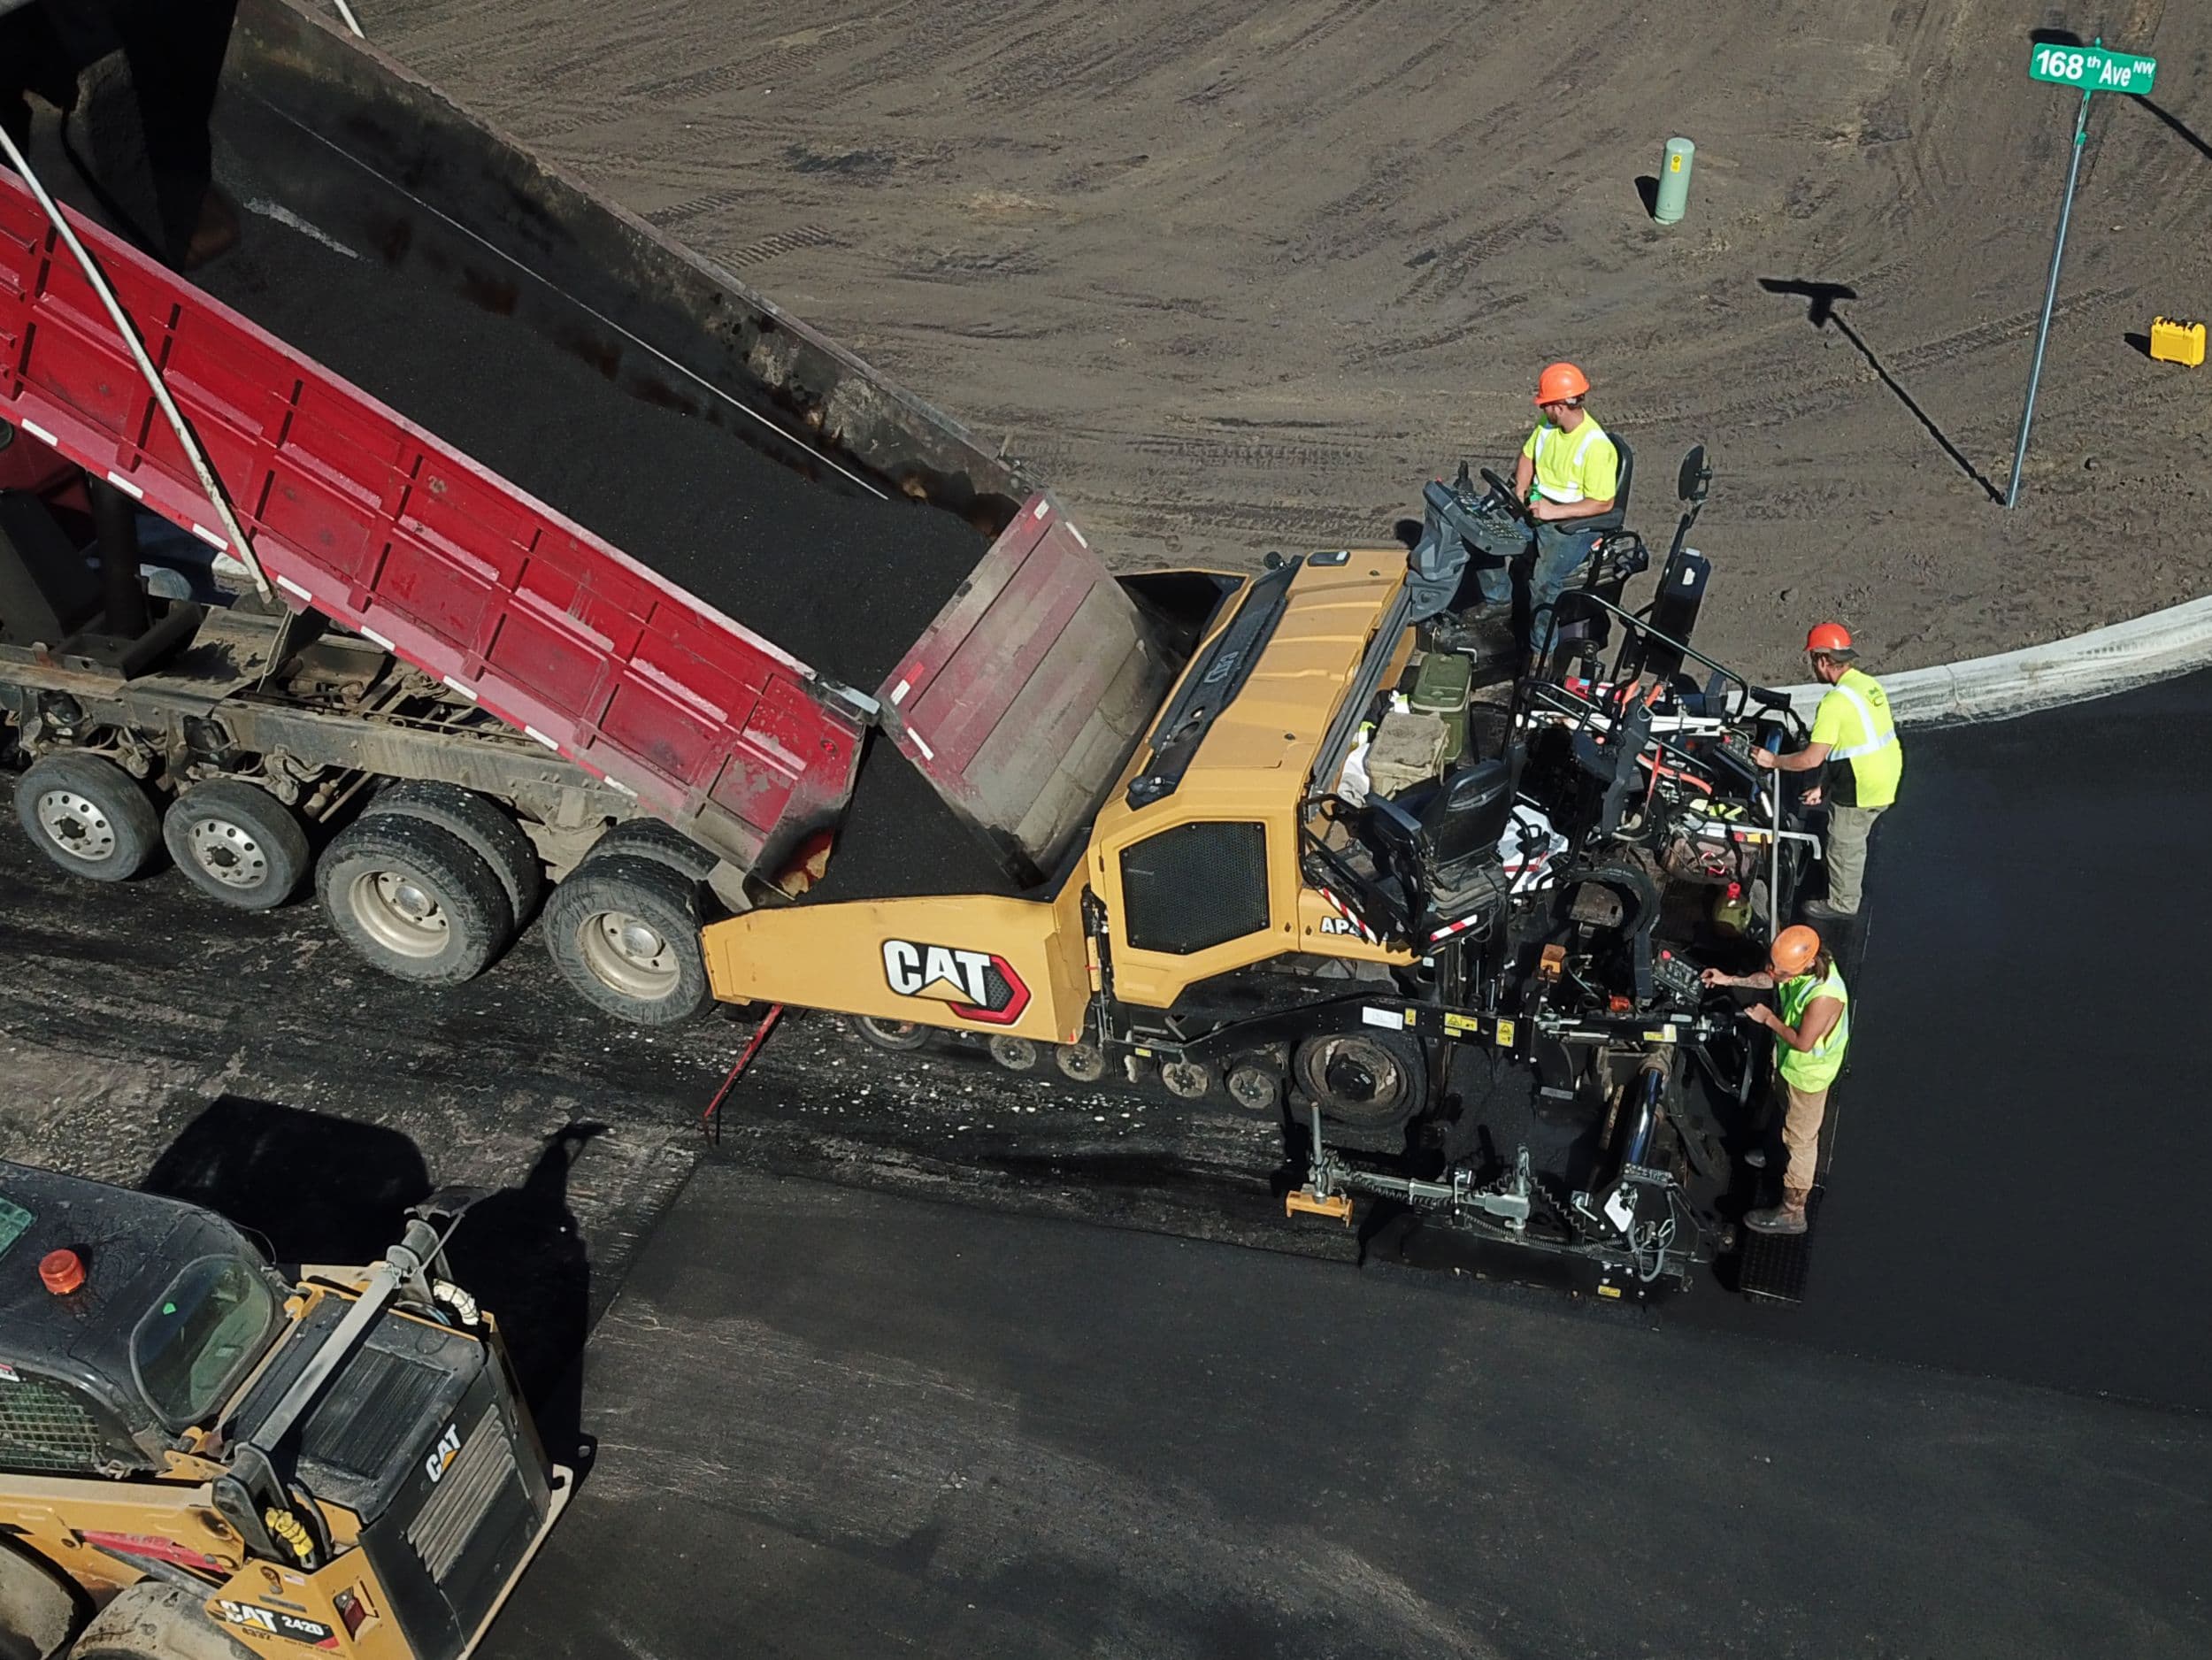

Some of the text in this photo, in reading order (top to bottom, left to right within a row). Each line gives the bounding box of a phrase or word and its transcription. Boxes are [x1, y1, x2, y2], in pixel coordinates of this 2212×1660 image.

[2099, 58, 2132, 87] Ave
[2133, 60, 2156, 76] NW
[883, 940, 992, 1007] CAT
[426, 1423, 461, 1482] CAT
[219, 1600, 278, 1633] CAT
[281, 1615, 325, 1636] 242D
